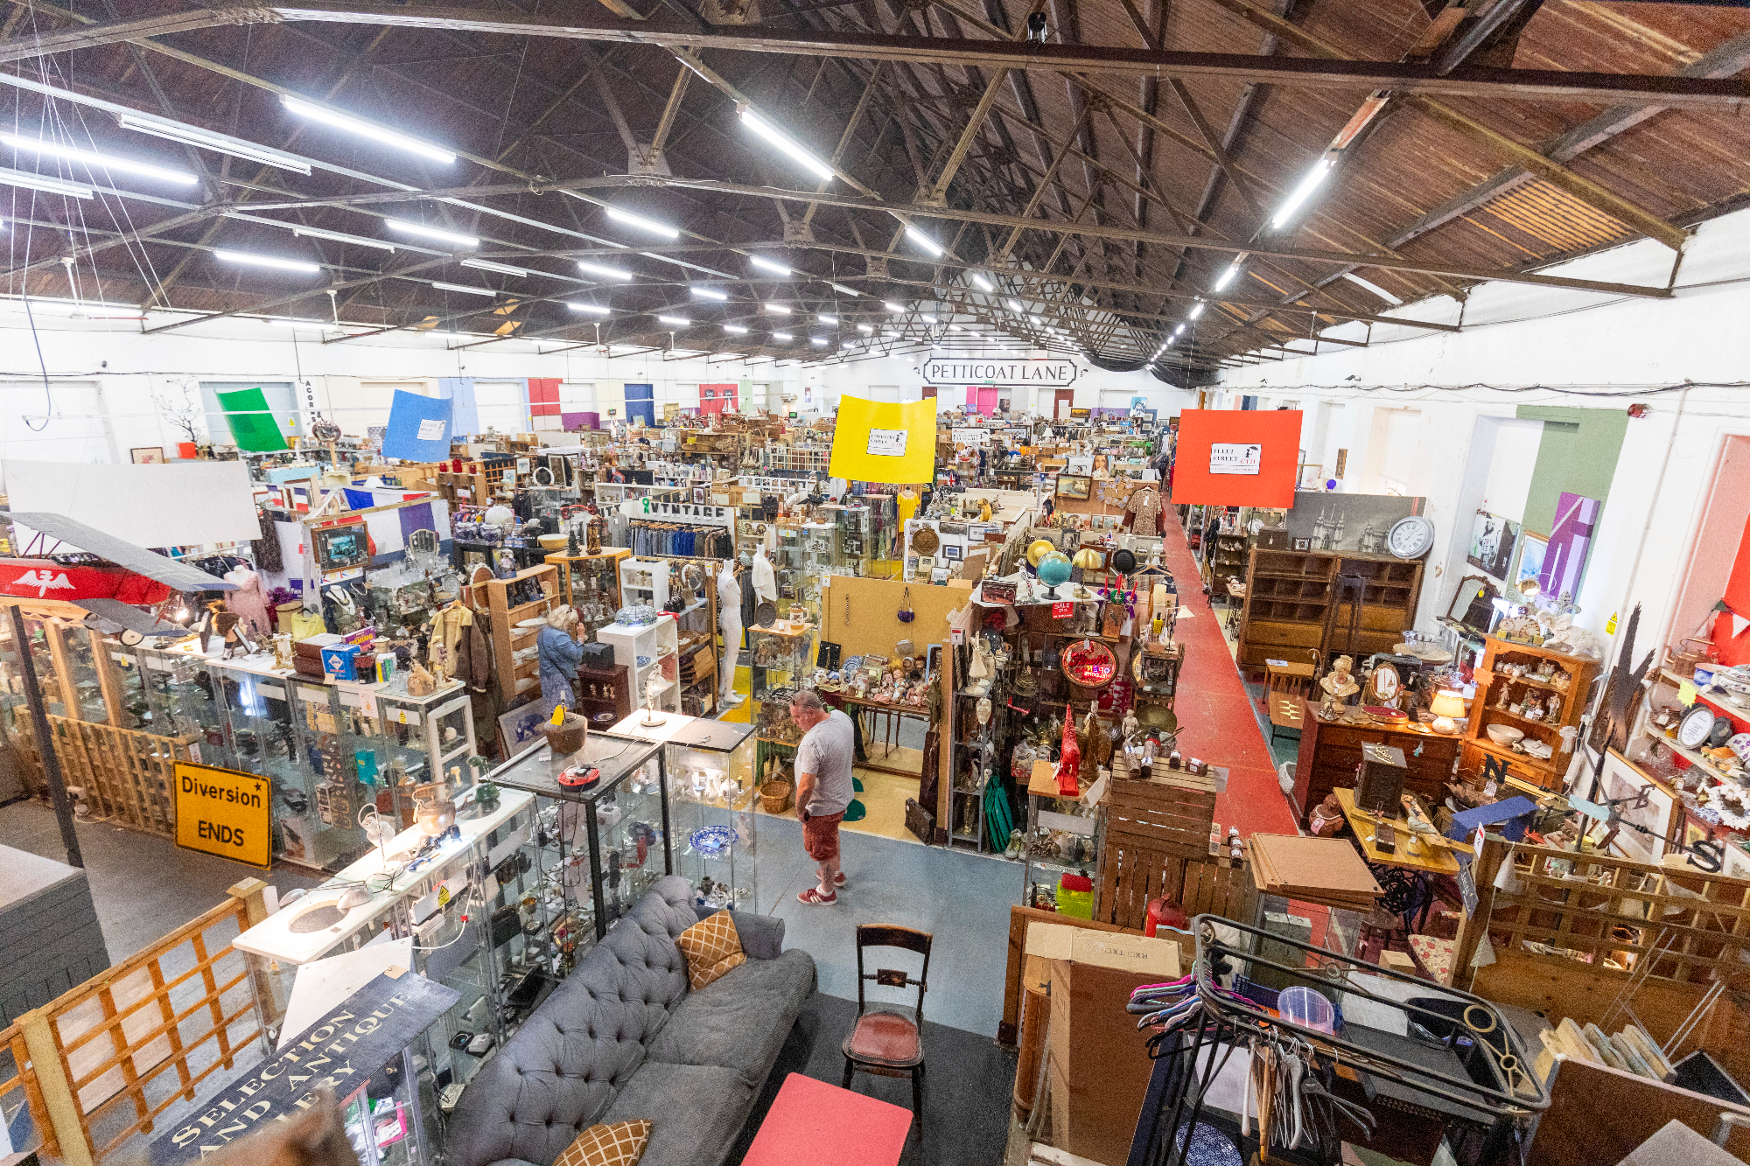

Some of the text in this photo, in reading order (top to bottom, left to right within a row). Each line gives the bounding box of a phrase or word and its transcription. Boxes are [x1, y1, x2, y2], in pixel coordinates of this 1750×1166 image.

[932, 364, 1067, 380] PETTICOAT LANE
[1482, 753, 1512, 785] N
[182, 776, 261, 808] Diversion
[198, 820, 245, 847] ENDS
[171, 1009, 355, 1150] SELECTION
[199, 991, 413, 1161] AND ANTIQUE
